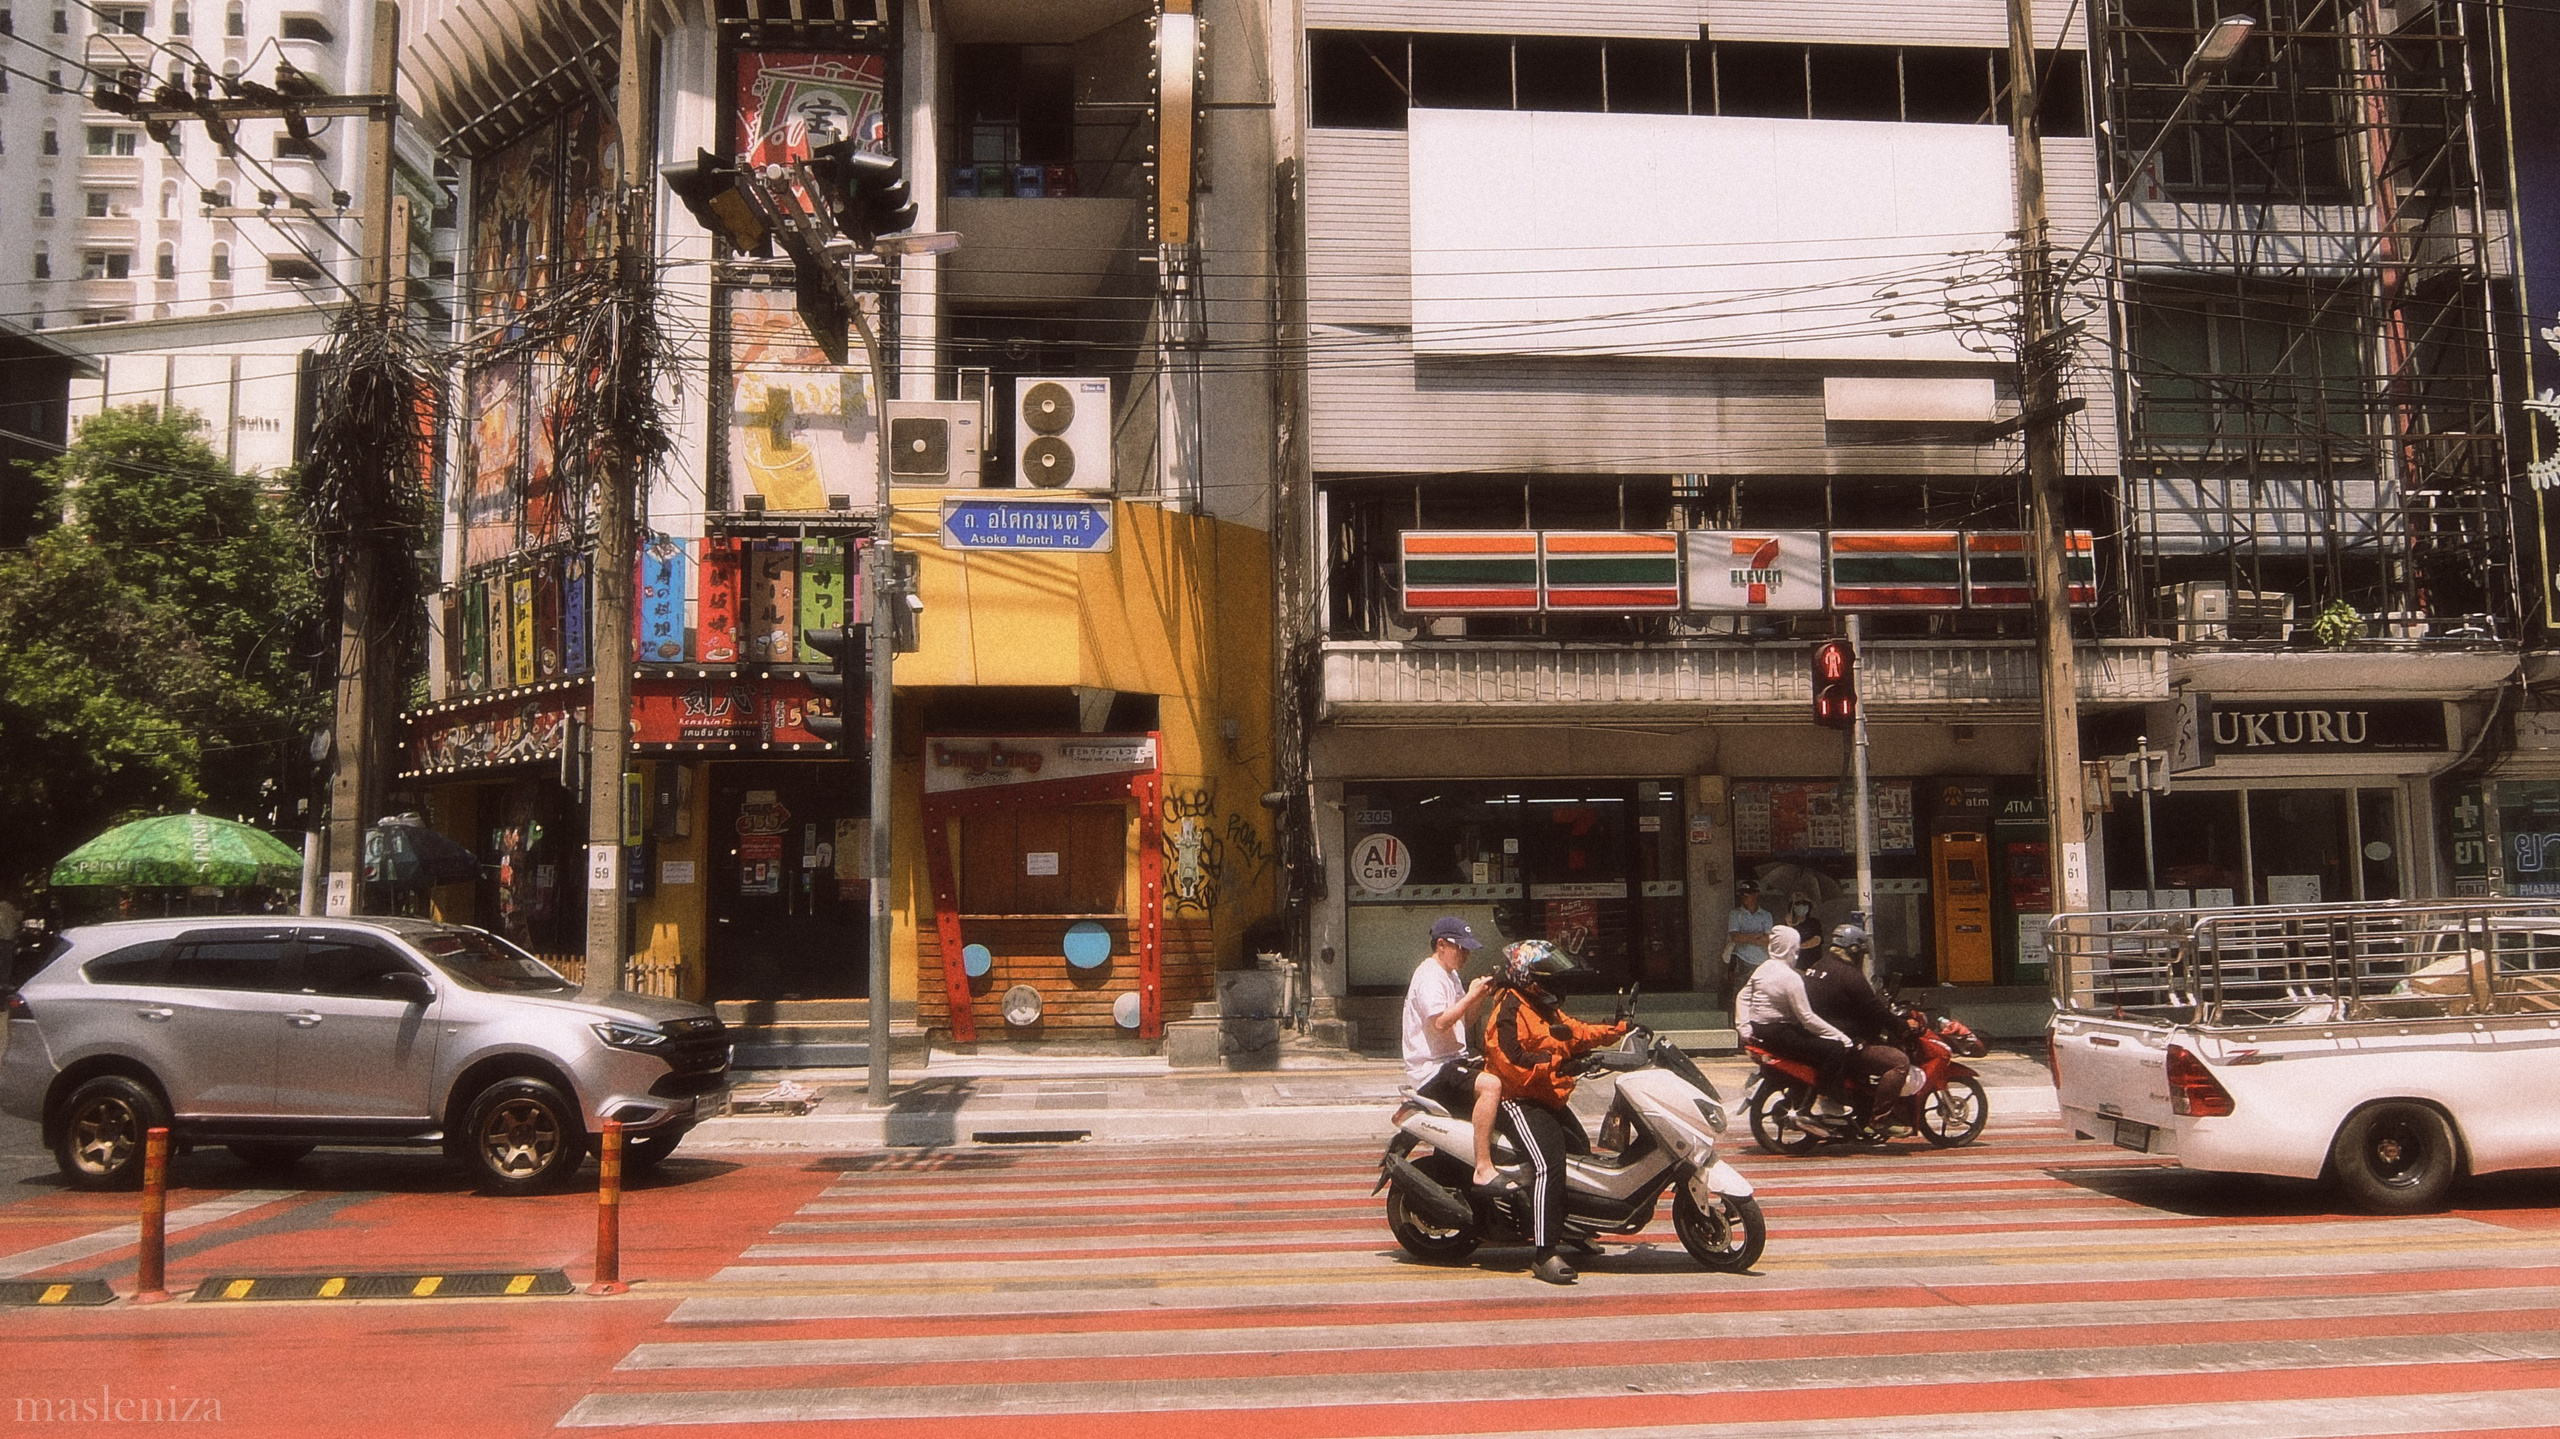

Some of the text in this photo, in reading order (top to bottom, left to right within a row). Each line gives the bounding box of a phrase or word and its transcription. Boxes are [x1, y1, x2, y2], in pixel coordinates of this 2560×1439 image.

[964, 505, 1091, 530] ถ. อโศกมนตรี
[971, 534, 1084, 545] Asoke Montri Rd.
[1731, 537, 1779, 604] 7
[761, 556, 790, 624] ビール
[812, 570, 833, 628] サワー
[679, 681, 757, 716] 剣心
[1965, 797, 1989, 807] atm
[2004, 801, 2033, 813] ATM
[1357, 811, 1391, 824] 2305
[1364, 838, 1397, 866] All
[2455, 841, 2484, 865] ยา
[595, 867, 609, 879] 59
[1364, 866, 1397, 879] Café
[2067, 867, 2079, 879] 61
[331, 895, 346, 906] 57
